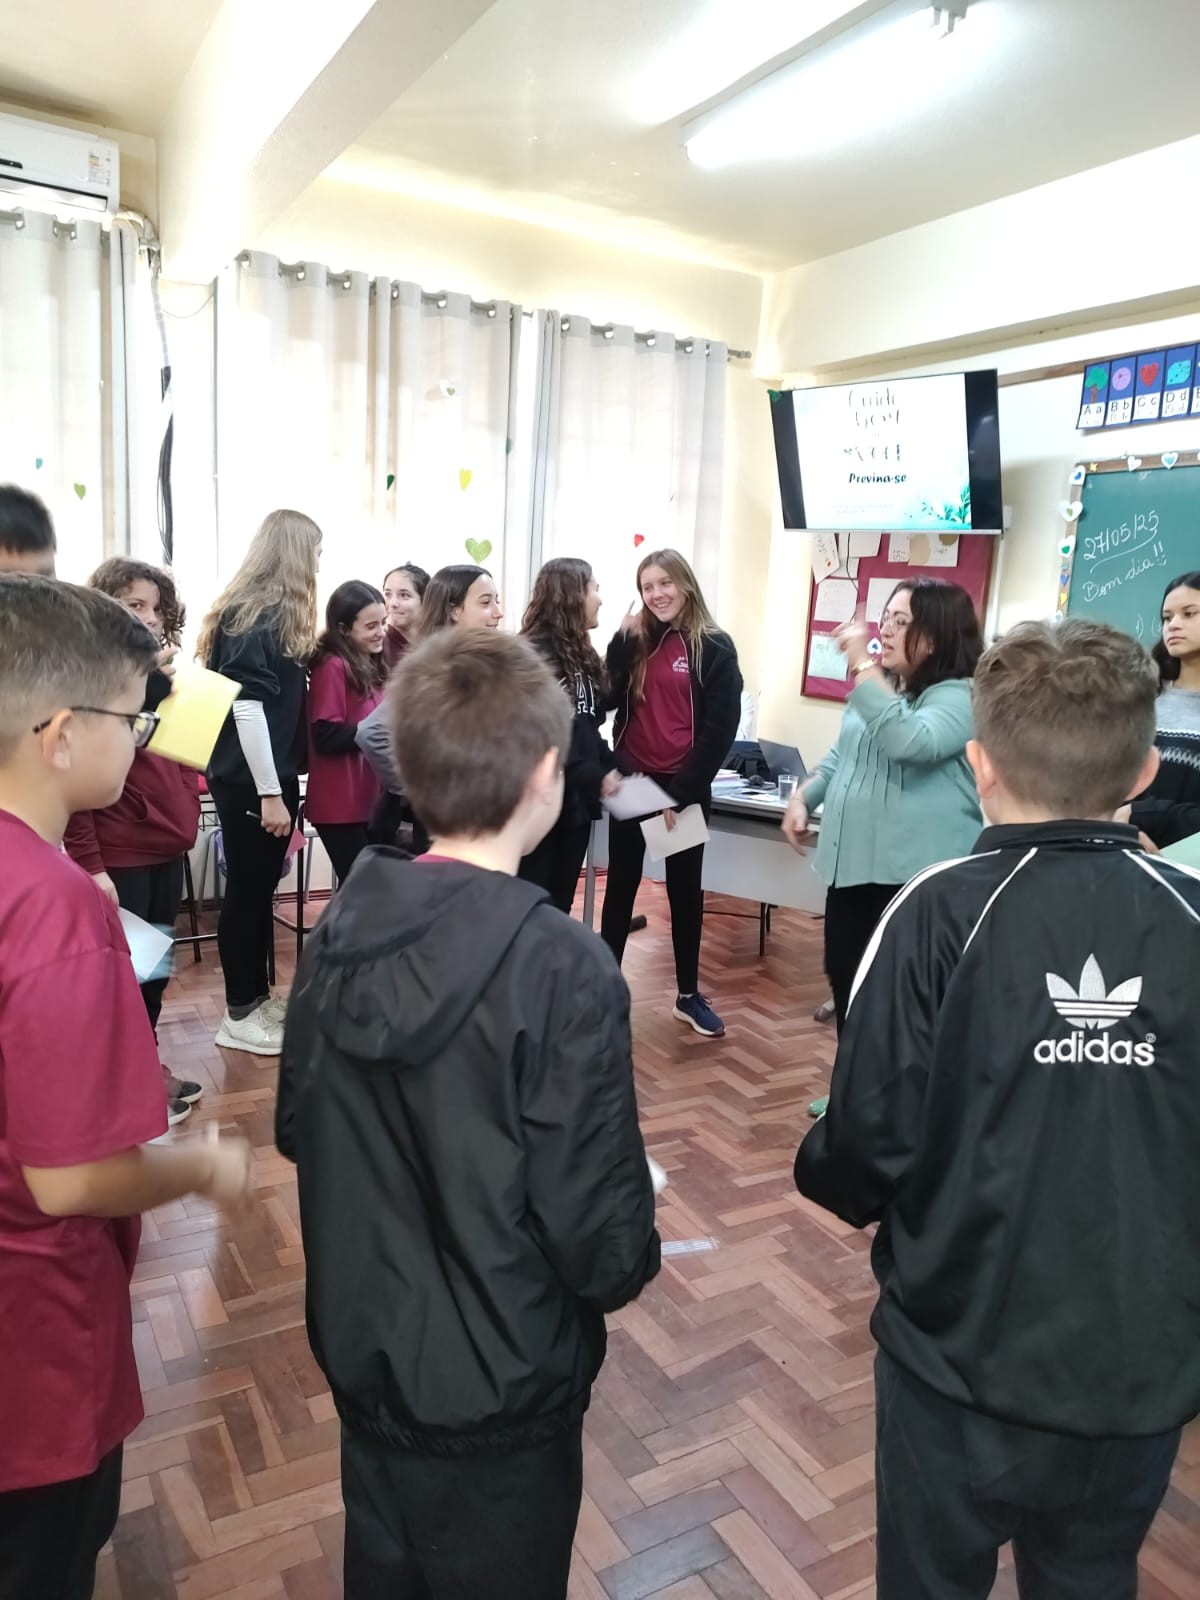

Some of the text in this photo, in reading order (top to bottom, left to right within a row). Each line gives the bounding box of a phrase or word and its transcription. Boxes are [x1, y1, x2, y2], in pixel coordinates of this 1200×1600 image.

[848, 472, 907, 484] Previna-se
[1083, 510, 1159, 561] 27/05/25
[1082, 576, 1122, 603] Bom
[1033, 1030, 1156, 1067] adidas
